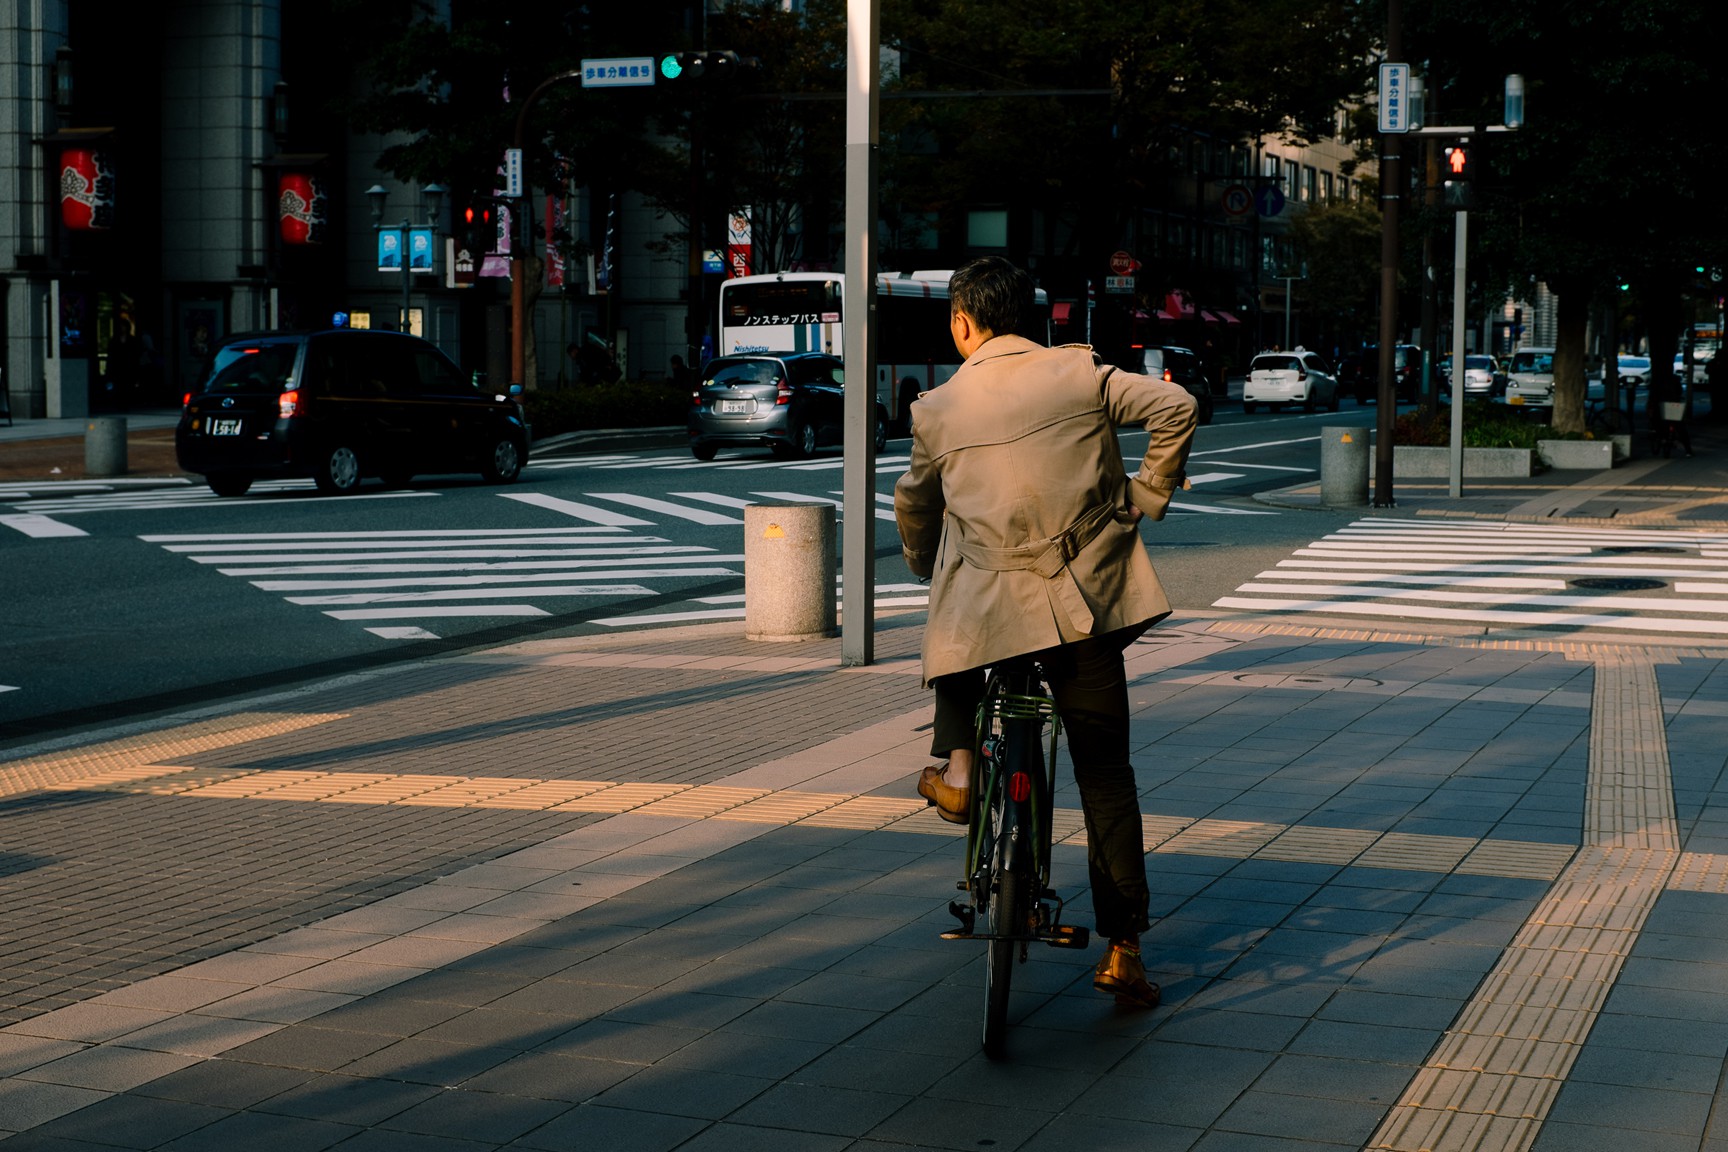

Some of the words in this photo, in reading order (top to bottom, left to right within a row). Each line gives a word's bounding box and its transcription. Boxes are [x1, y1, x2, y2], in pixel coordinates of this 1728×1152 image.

[586, 66, 650, 79] 歩車分離信号
[1389, 68, 1399, 128] 歩車分離信号
[743, 314, 819, 326] ノンステップバス
[733, 345, 769, 353] Nishitetsu
